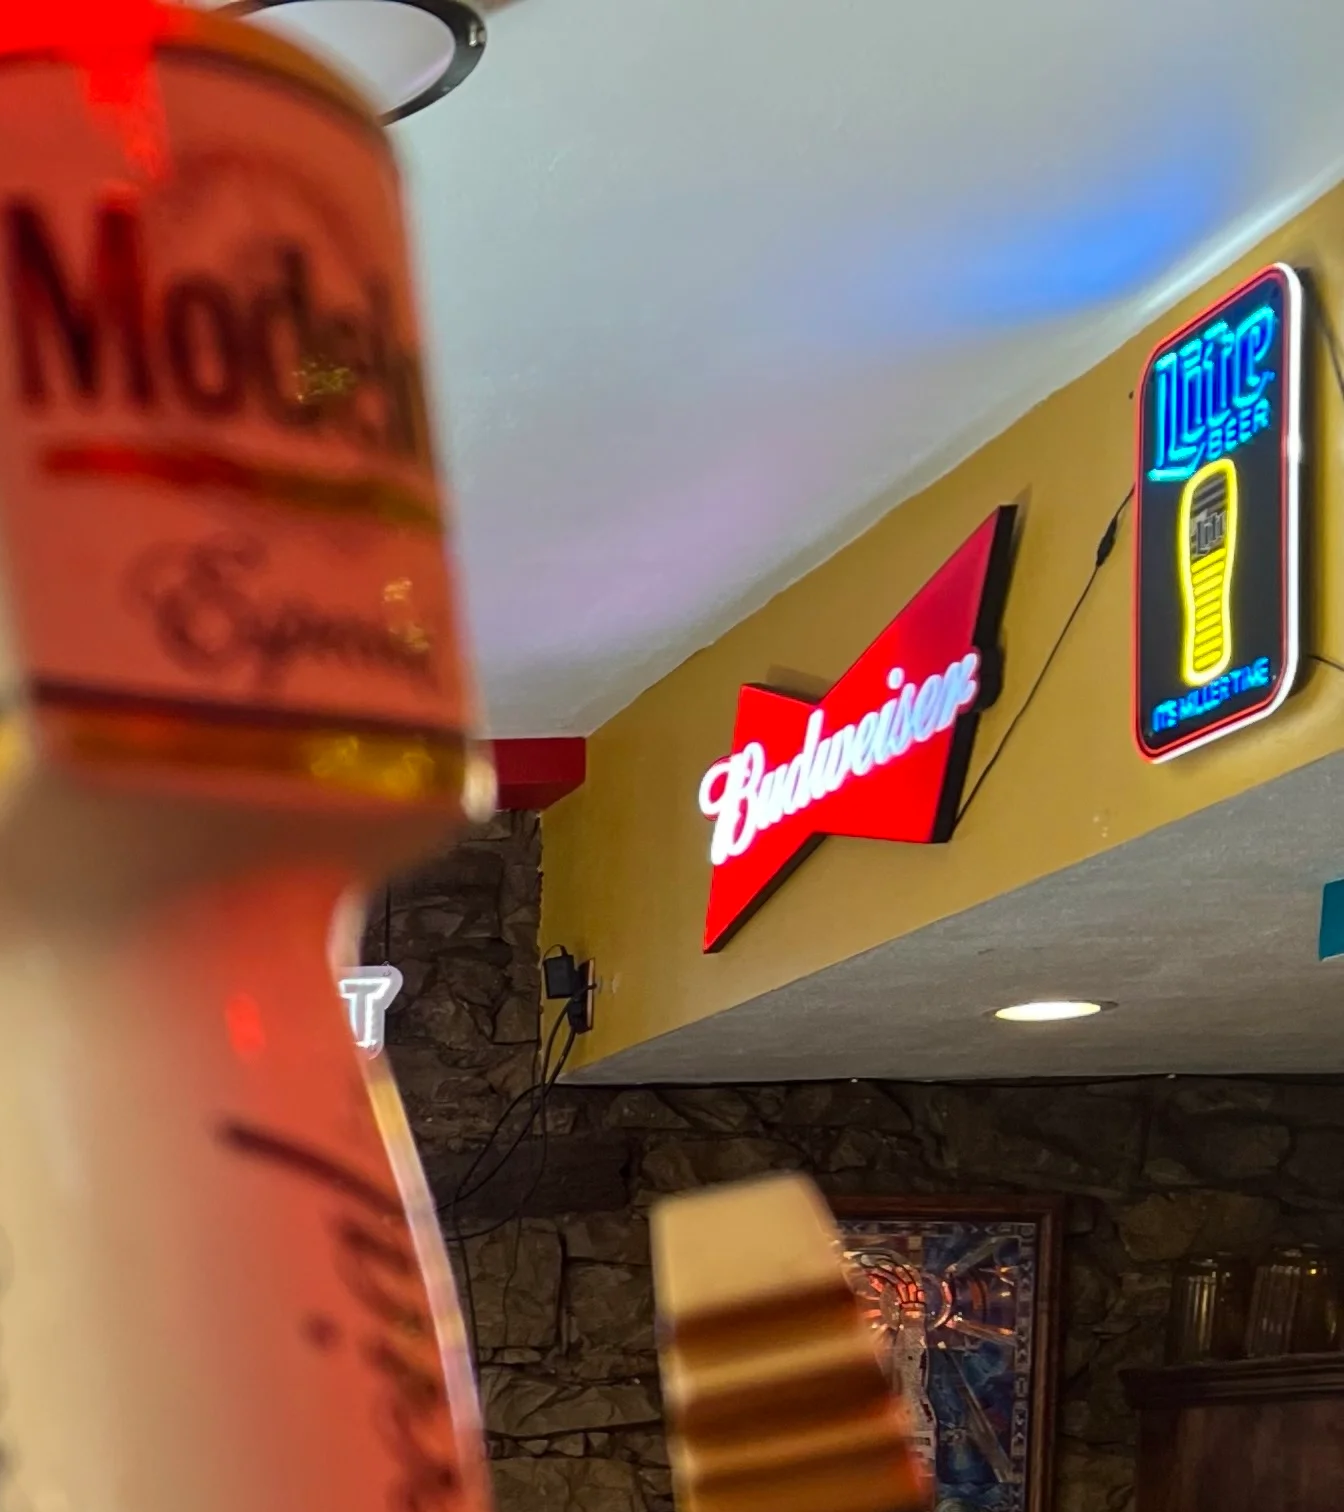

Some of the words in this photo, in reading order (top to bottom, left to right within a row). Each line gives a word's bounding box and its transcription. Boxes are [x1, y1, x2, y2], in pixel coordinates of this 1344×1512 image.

[1148, 306, 1275, 482] Lite
[1206, 398, 1270, 461] BEER
[699, 652, 979, 866] Budweiser
